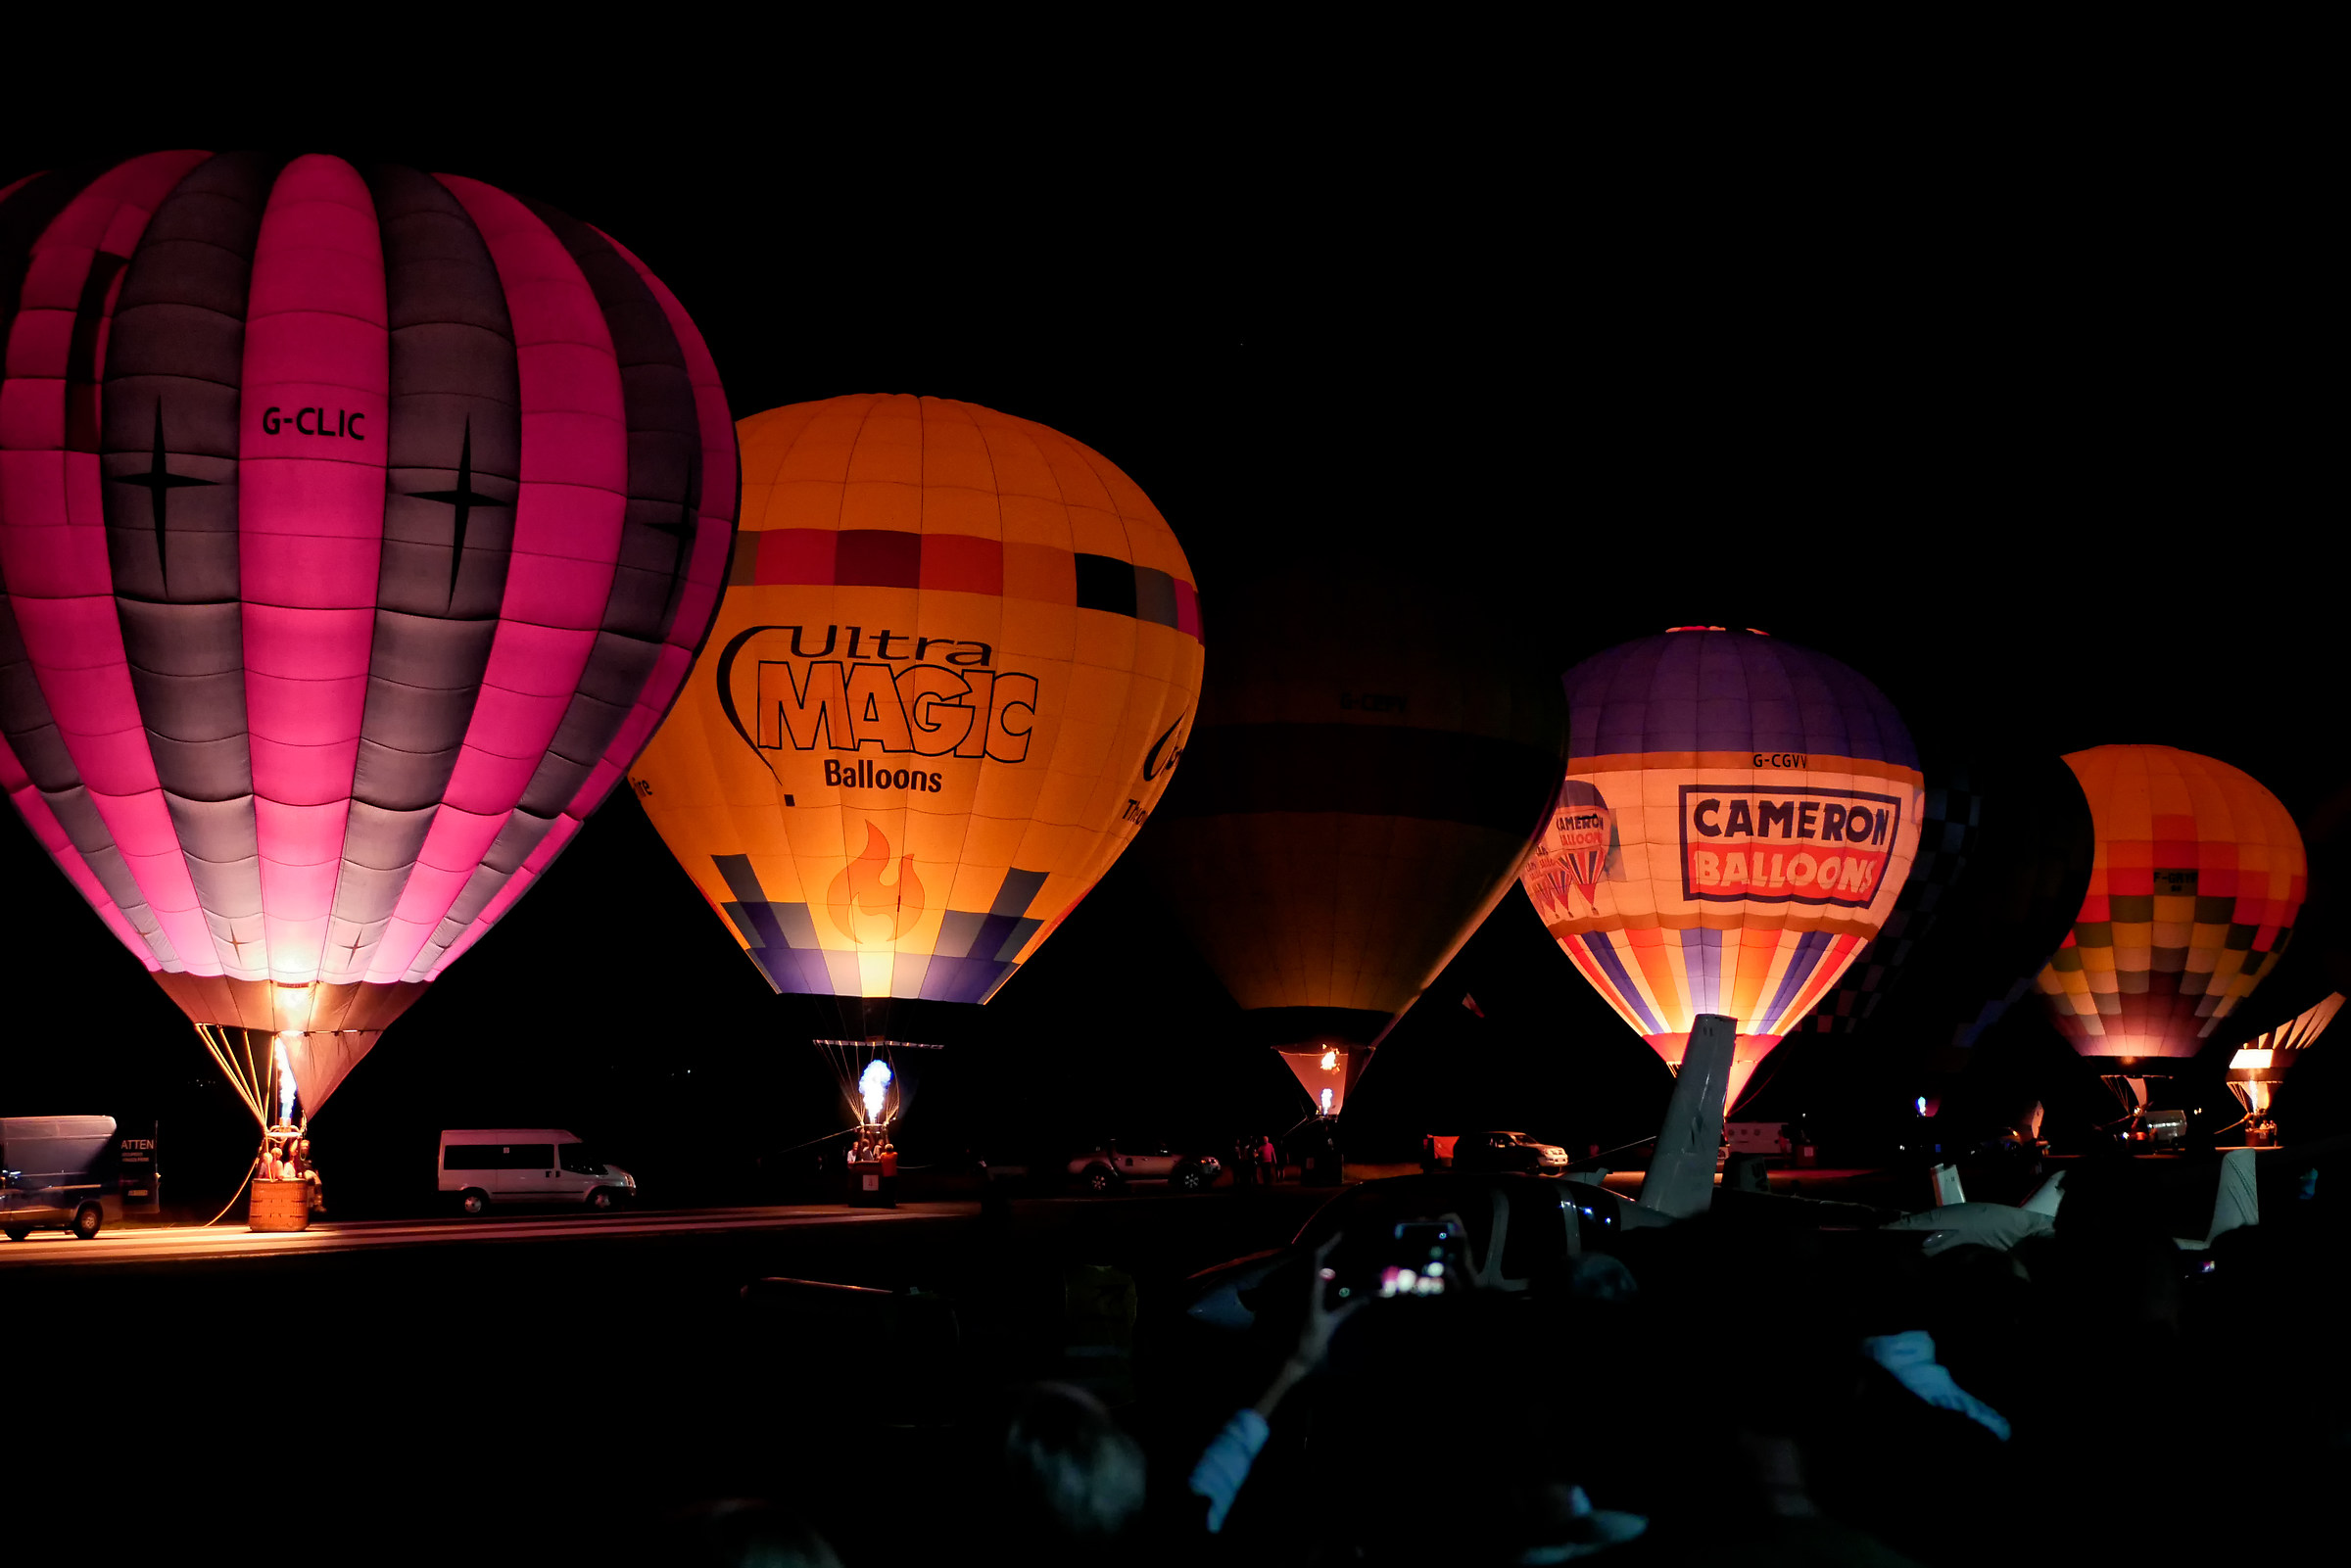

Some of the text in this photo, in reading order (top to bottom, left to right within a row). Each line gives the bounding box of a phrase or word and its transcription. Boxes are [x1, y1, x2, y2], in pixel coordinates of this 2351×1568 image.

[263, 406, 364, 441] G-CLIC
[784, 625, 992, 667] Ultra
[757, 660, 1038, 763] MAGIC
[824, 759, 942, 793] Balloons
[1753, 753, 1807, 769] G-CGVV
[1693, 797, 1890, 845] CAMERON
[1693, 850, 1878, 894] BALLOONS
